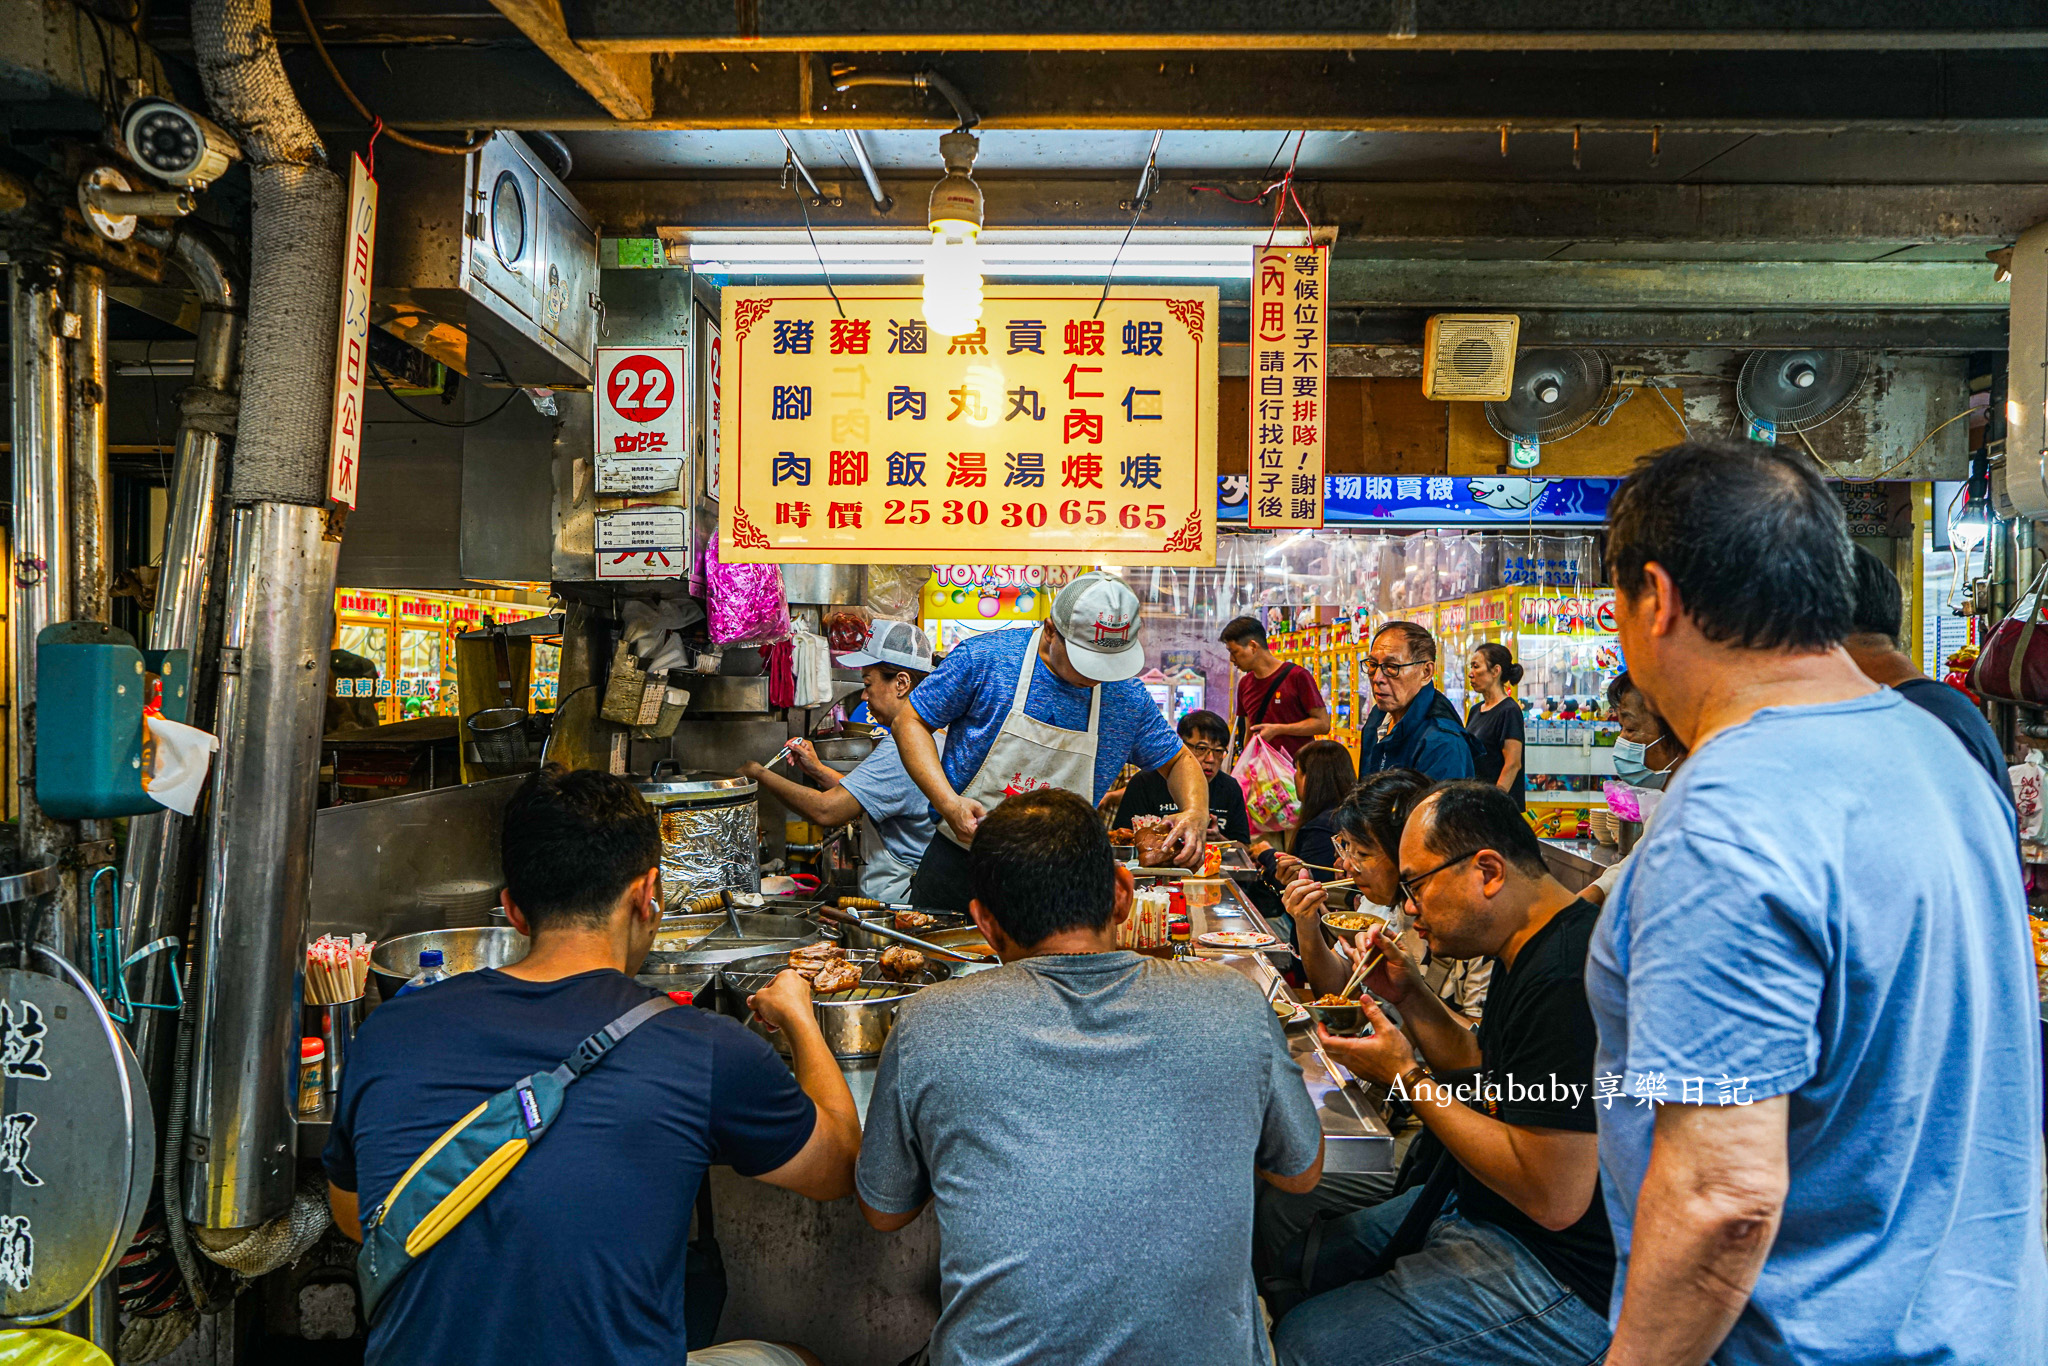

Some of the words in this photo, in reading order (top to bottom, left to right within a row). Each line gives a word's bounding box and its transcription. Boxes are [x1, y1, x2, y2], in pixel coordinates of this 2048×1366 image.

[615, 368, 667, 409] 22
[771, 318, 814, 487] 豬腳肉
[828, 318, 871, 487] 豬腳
[886, 318, 928, 488] 滷肉飯
[946, 318, 989, 488] 魚丸湯
[1003, 318, 1047, 488] 貢丸湯
[775, 501, 864, 530] 時價
[884, 499, 931, 525] 25
[942, 499, 989, 526] 30
[1001, 502, 1048, 529] 30
[1059, 499, 1107, 526] 65
[1118, 504, 1166, 530] 65
[1846, 523, 1887, 535] sage
[932, 565, 990, 587] TOY
[993, 565, 1081, 588] STORY
[1521, 597, 1563, 618] TOY
[336, 678, 431, 698] 遠東泡泡冰
